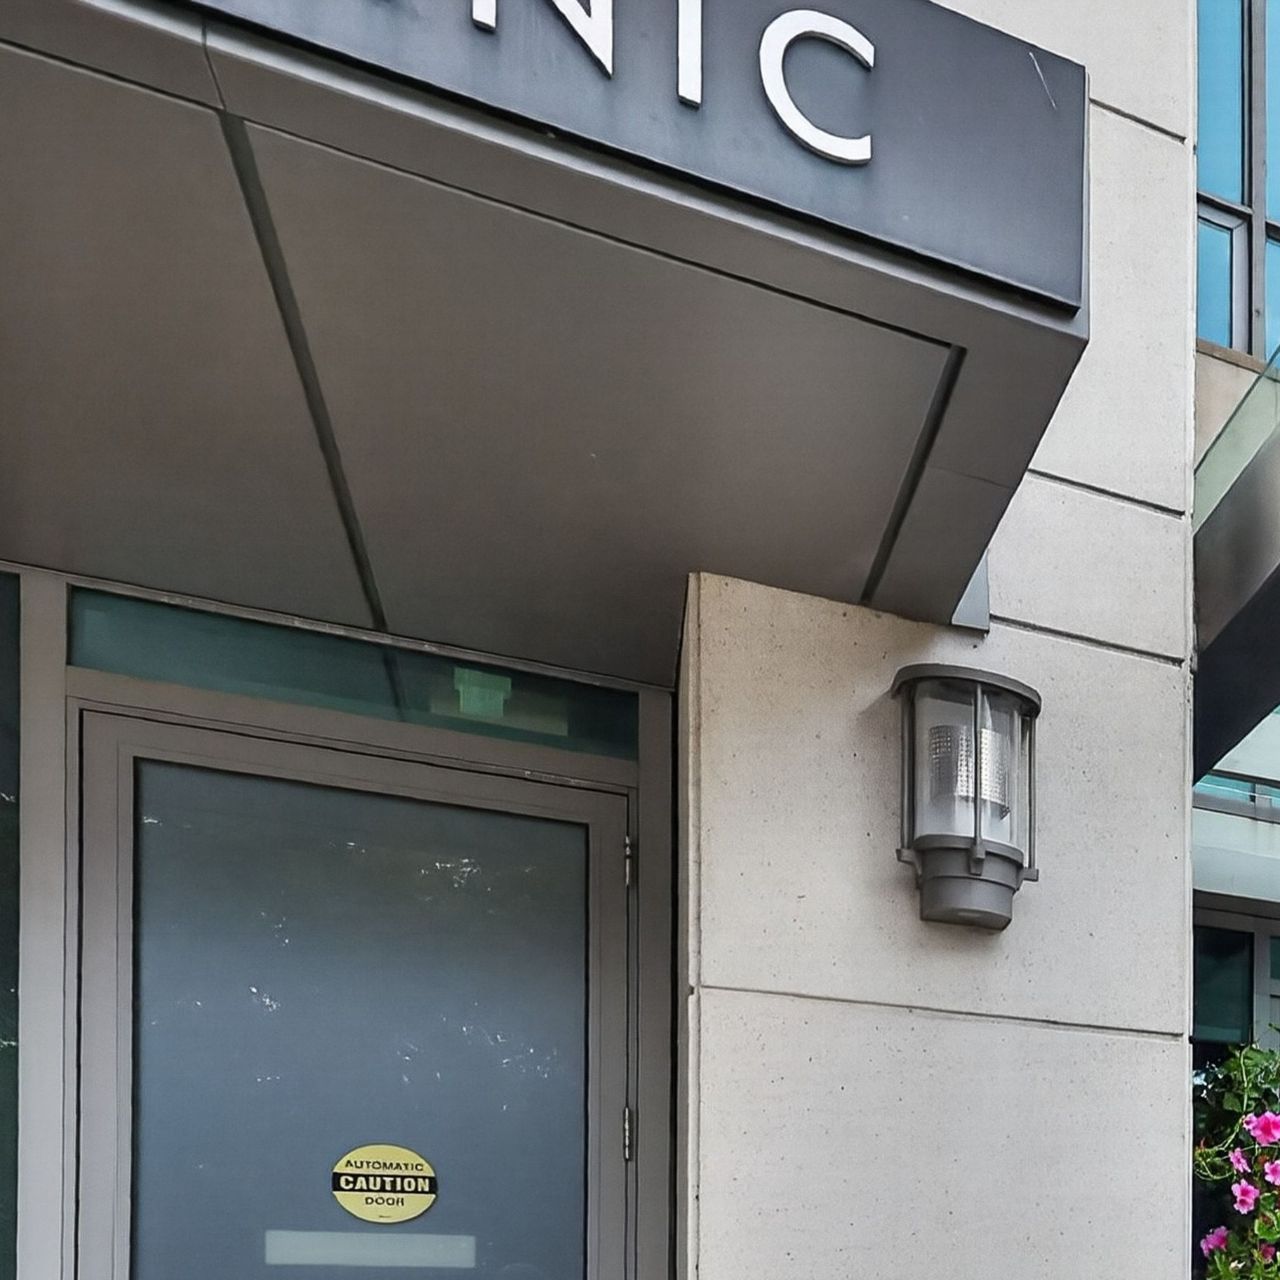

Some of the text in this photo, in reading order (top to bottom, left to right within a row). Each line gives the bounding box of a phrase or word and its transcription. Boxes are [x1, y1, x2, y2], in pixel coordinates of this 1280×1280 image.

[345, 1160, 424, 1171] AUTOMATIC
[340, 1175, 430, 1192] CAUTION
[365, 1197, 405, 1207] DOOR
